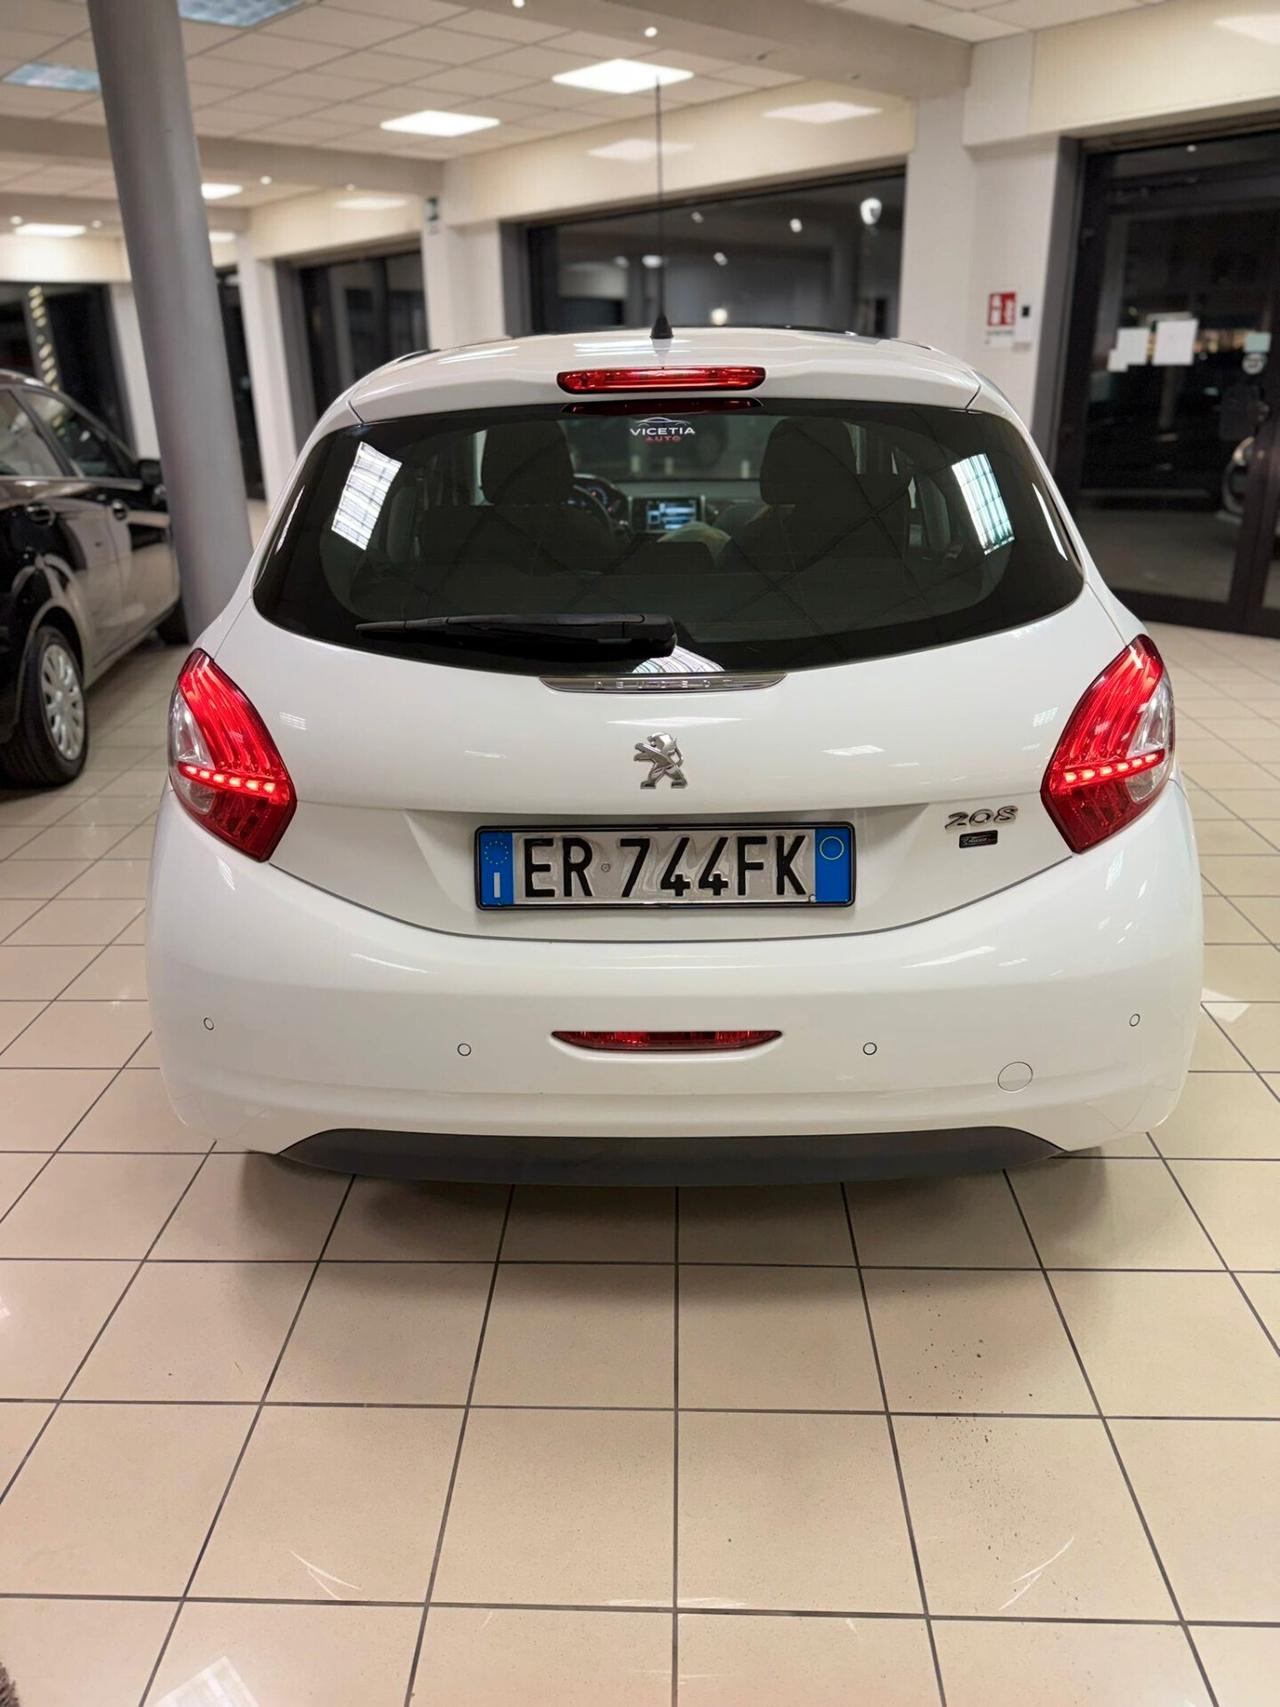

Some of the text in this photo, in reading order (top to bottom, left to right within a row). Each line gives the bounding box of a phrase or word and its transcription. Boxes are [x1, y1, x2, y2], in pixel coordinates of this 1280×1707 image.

[630, 427, 696, 436] VICETIA
[944, 805, 1018, 829] 208
[524, 835, 807, 897] ER 744FK
